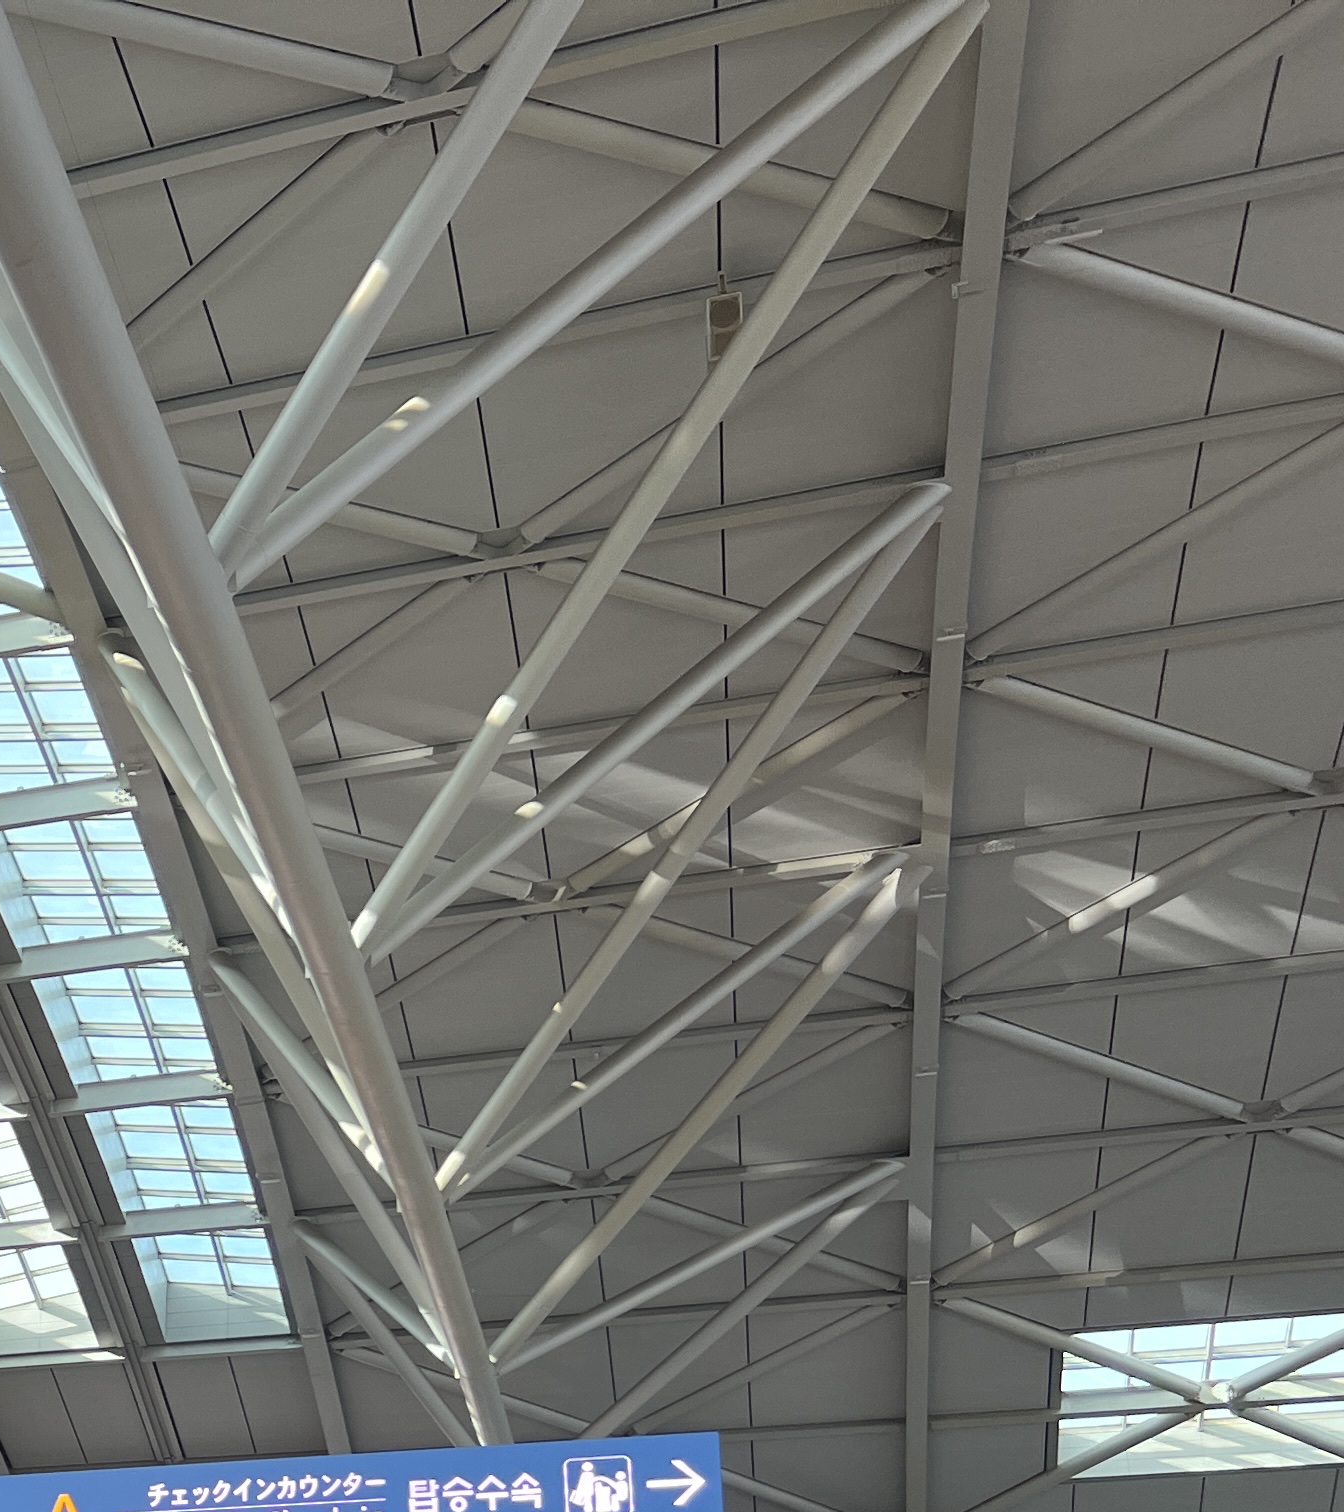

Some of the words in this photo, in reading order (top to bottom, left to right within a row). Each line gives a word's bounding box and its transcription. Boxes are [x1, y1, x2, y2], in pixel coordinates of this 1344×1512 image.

[147, 1472, 387, 1508] チェックインカウンター
